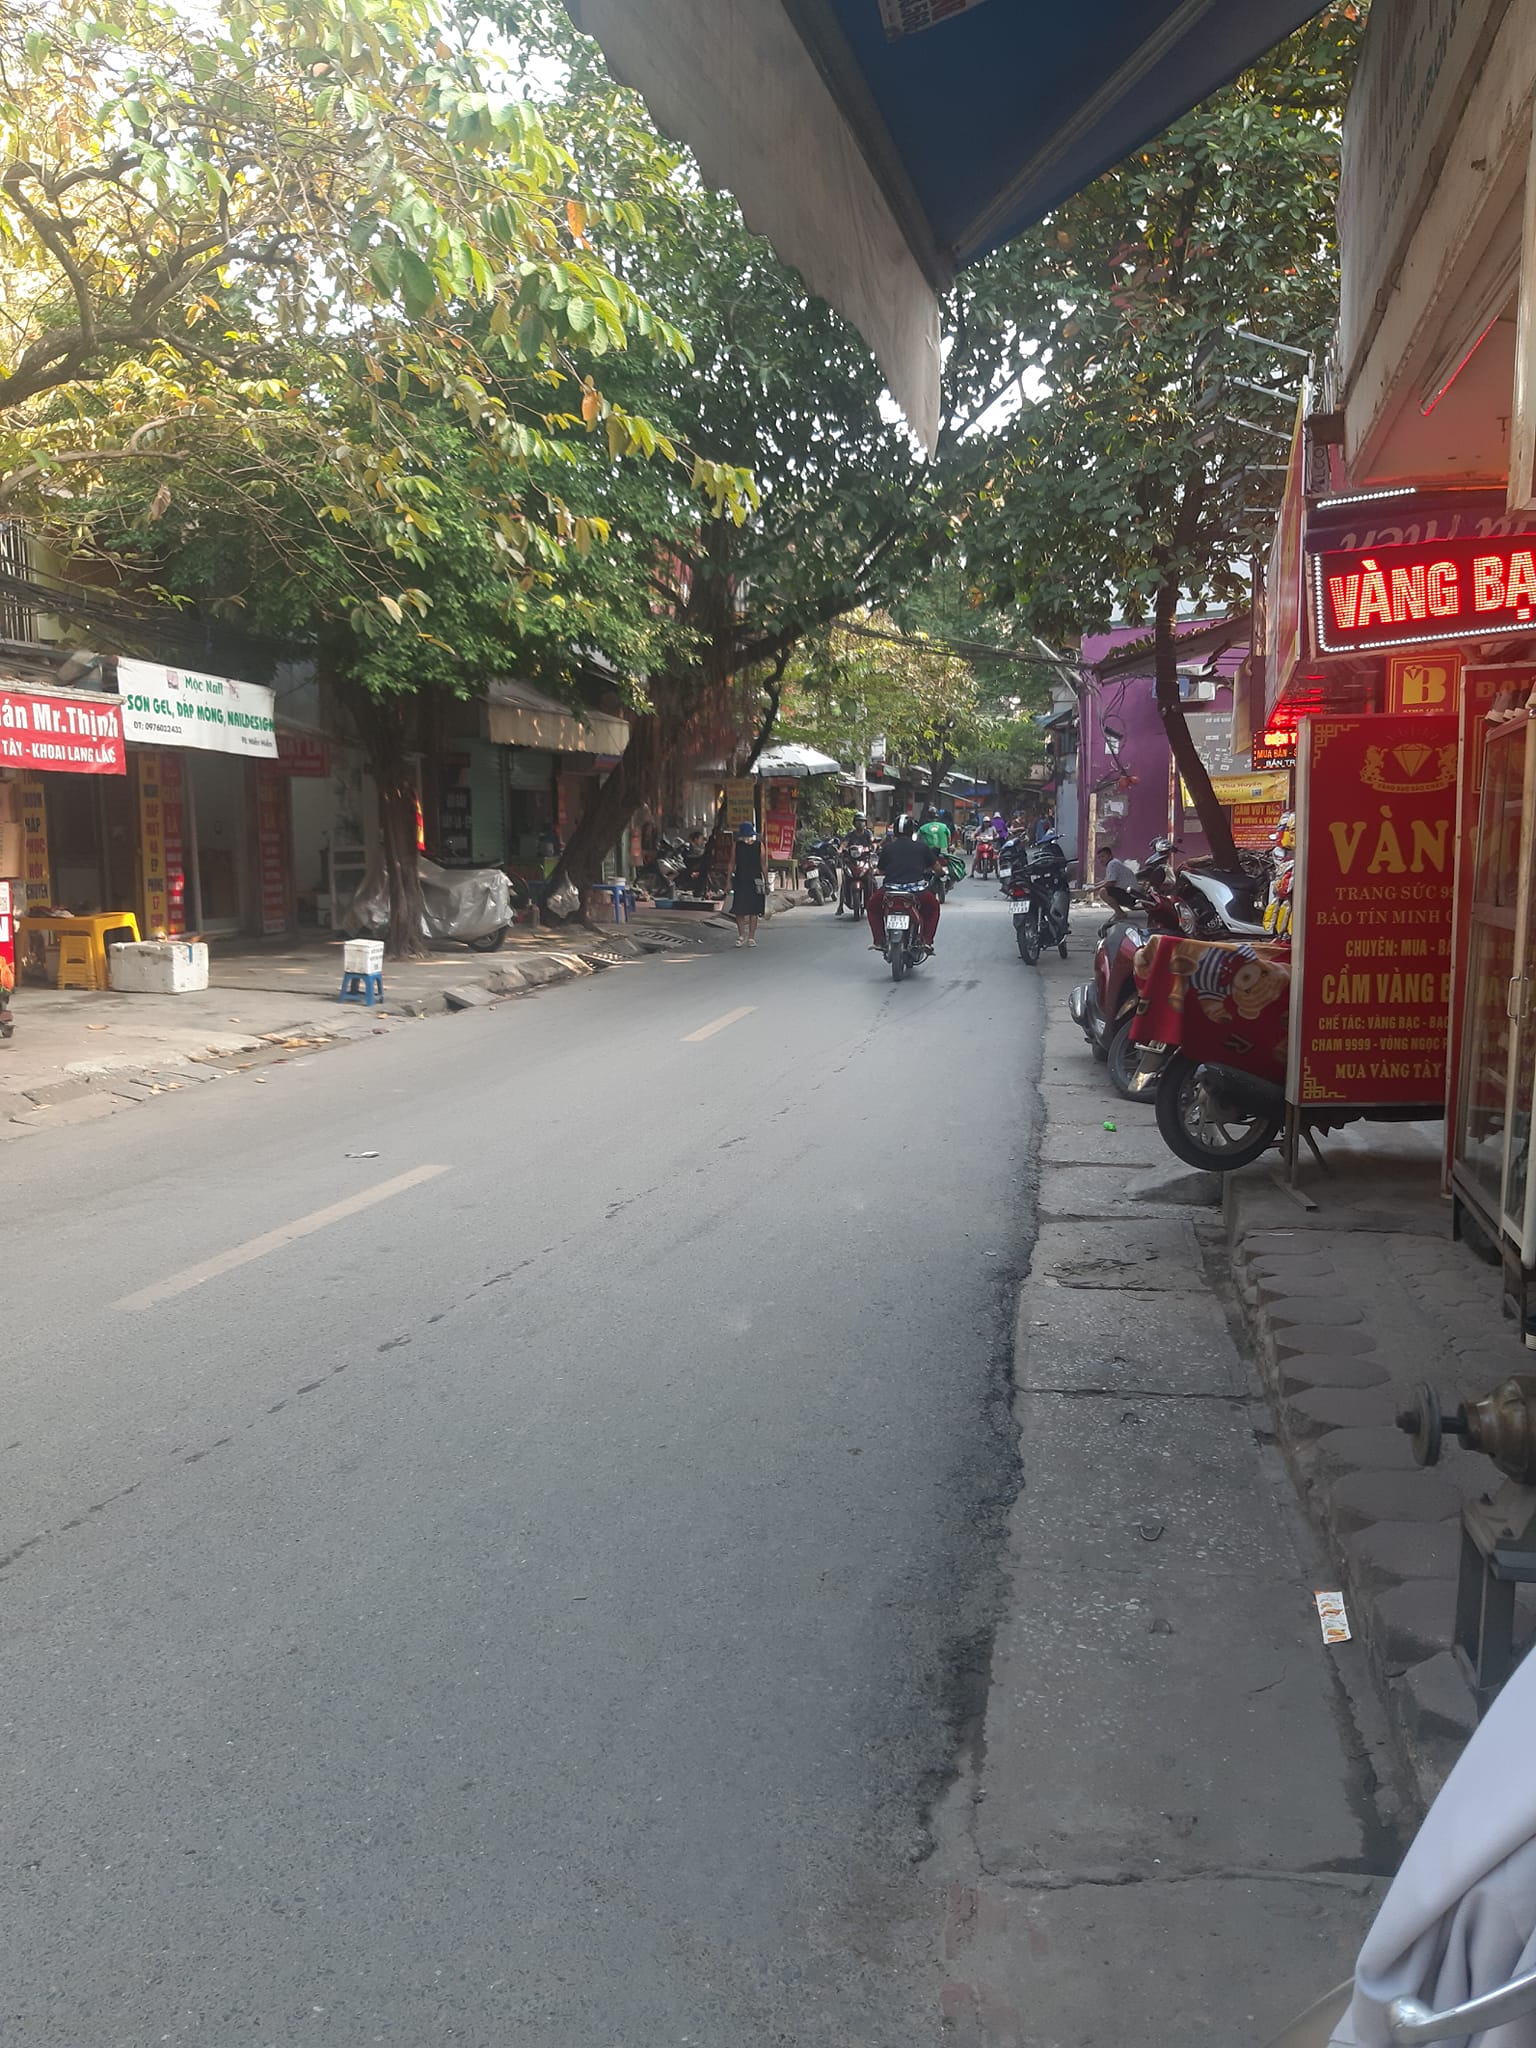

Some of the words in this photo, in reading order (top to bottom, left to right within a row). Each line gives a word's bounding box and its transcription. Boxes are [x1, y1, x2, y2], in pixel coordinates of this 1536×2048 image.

[1329, 559, 1459, 629] VÀNG
[127, 694, 150, 711] SƠN
[0, 698, 28, 730] án
[32, 742, 66, 761] KHOAI
[67, 745, 95, 763] LANG
[1328, 804, 1456, 875] VÀN
[1335, 886, 1397, 901] TRANG
[1401, 882, 1437, 899] SỨC
[1316, 906, 1353, 926] BẢO
[1356, 907, 1389, 925] TÍN
[1392, 910, 1441, 924] MINH
[1345, 936, 1398, 958] CHUYÊN:
[1401, 940, 1428, 956] MUA
[1376, 967, 1435, 1003] VÀNG
[1318, 1014, 1340, 1030] CHẾ
[1367, 1014, 1396, 1029] VÀNG
[1399, 1016, 1420, 1032] BẠC
[1344, 1038, 1371, 1050] 9999
[1335, 1063, 1367, 1079] MUA
[1370, 1059, 1410, 1078] VÀNG
[1413, 1059, 1441, 1078] TÂY
